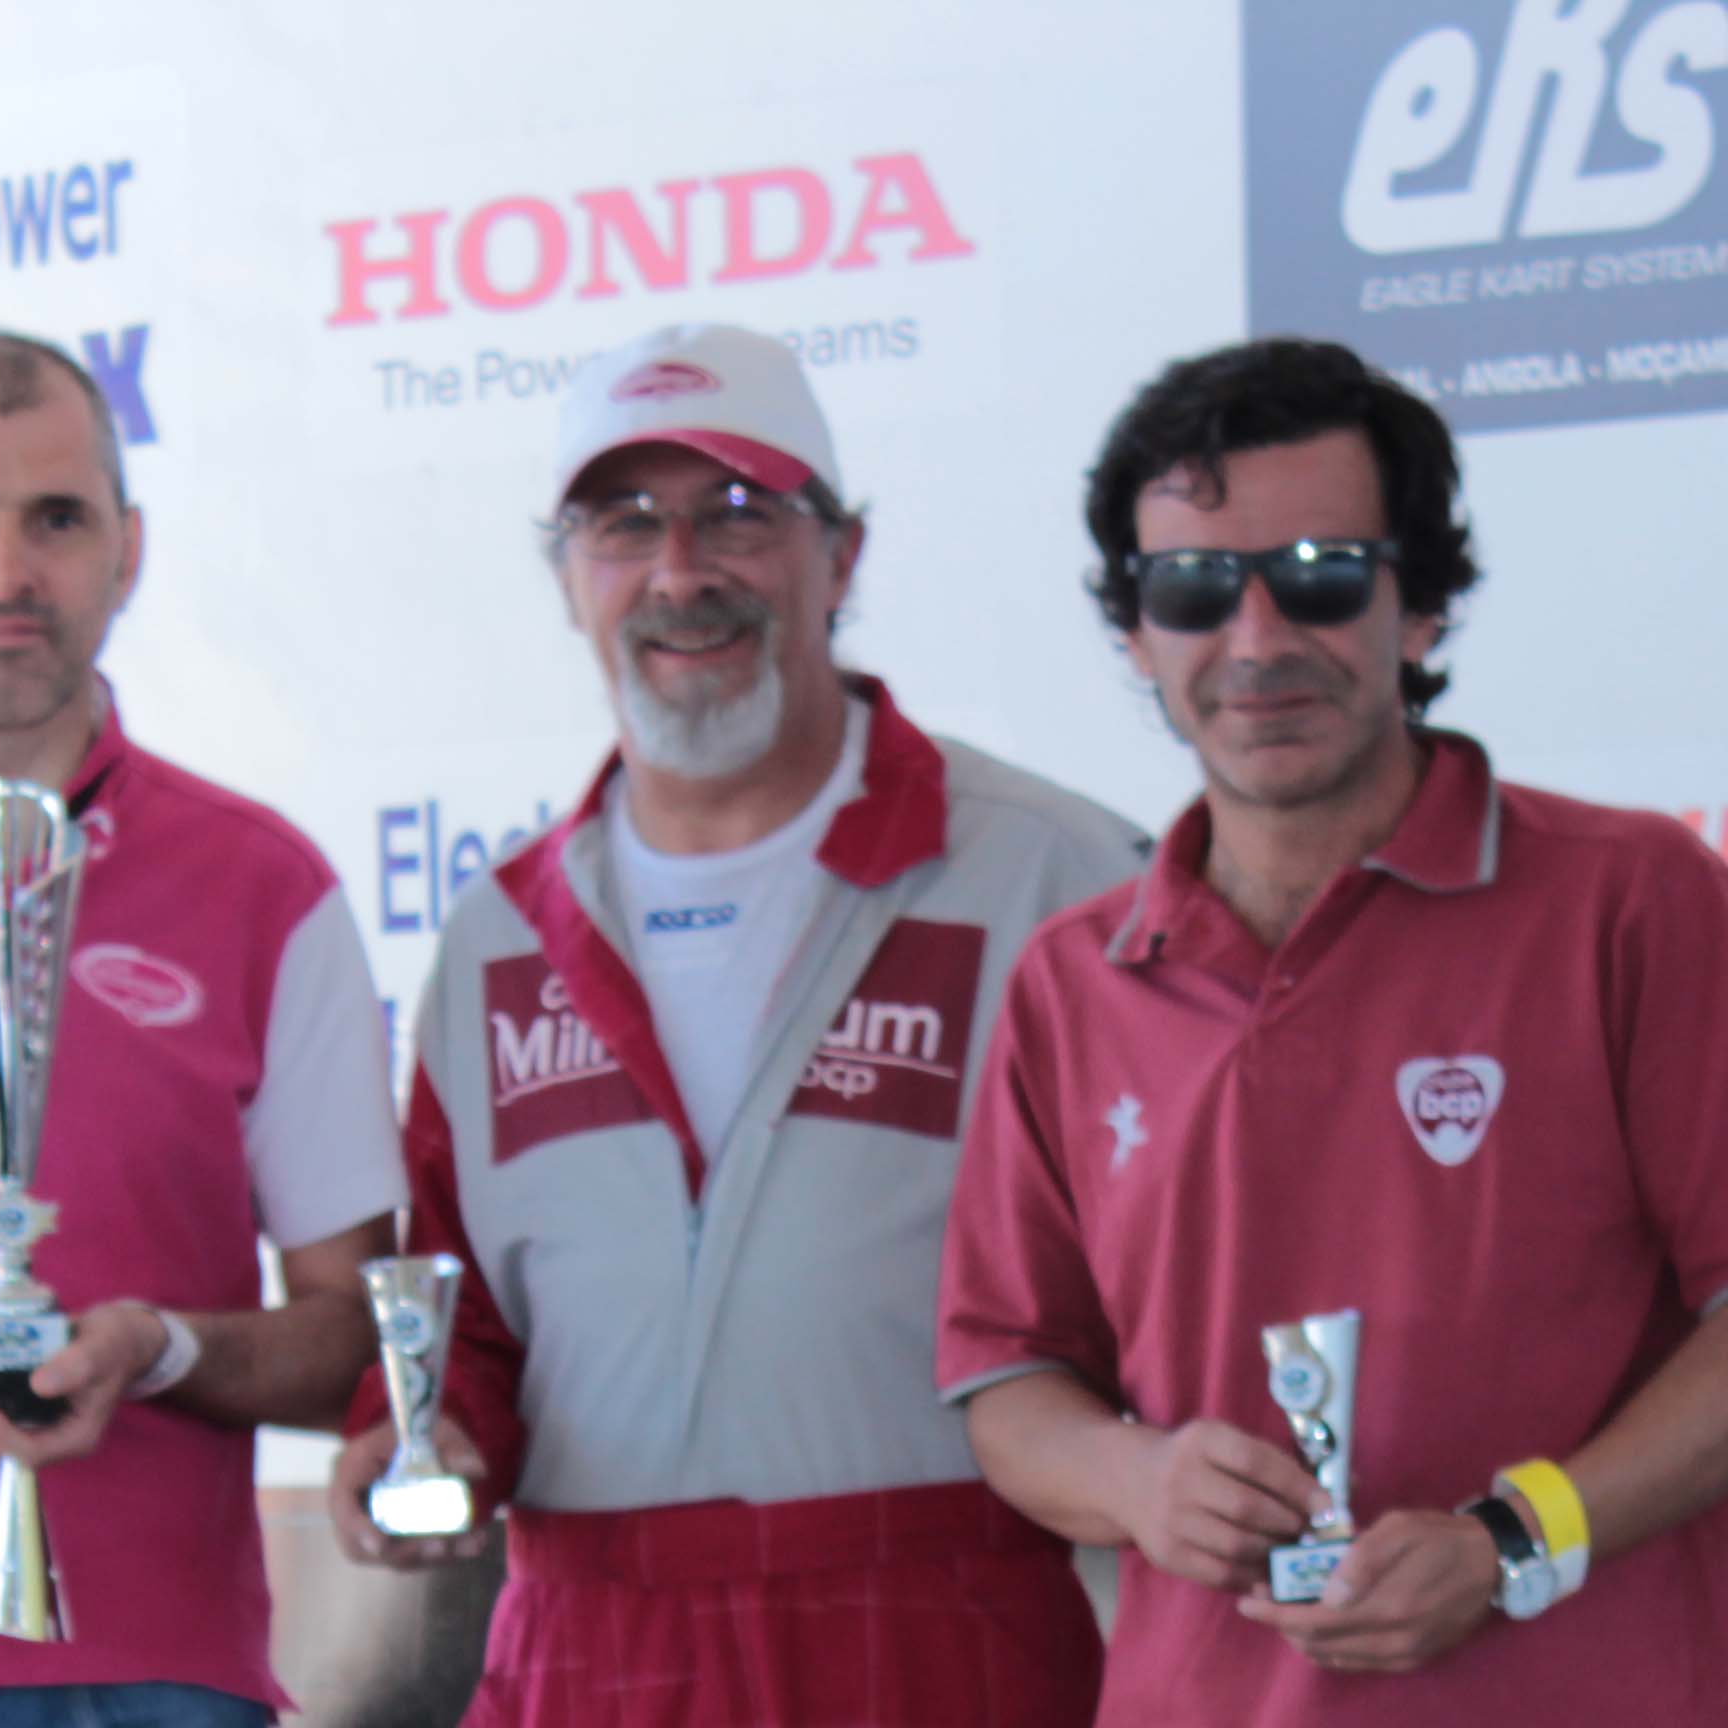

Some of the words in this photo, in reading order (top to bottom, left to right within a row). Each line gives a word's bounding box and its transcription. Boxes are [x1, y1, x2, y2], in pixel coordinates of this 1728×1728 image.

[324, 152, 976, 328] HONDA
[1360, 270, 1472, 311] EAGLE
[1478, 259, 1573, 298] KART
[375, 358, 462, 410] The
[475, 347, 584, 401] Pow
[784, 315, 922, 368] eams
[1463, 350, 1584, 397] ANGOLA
